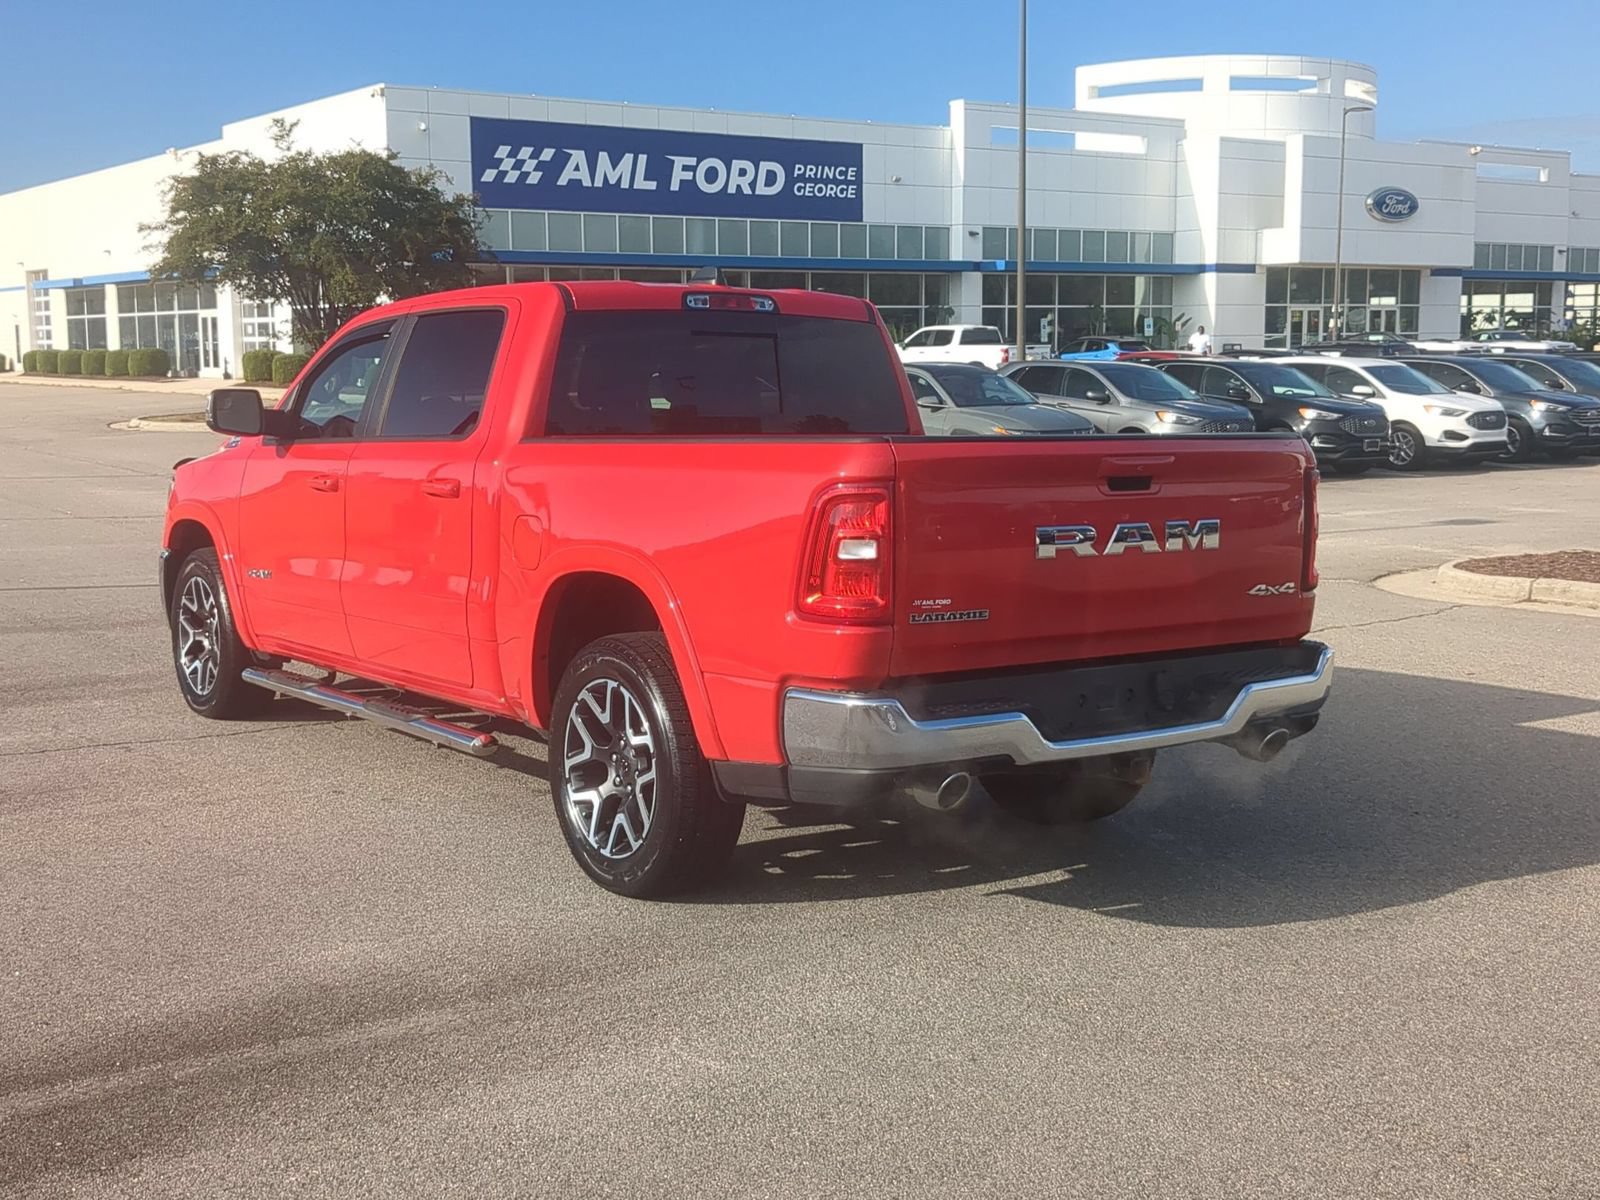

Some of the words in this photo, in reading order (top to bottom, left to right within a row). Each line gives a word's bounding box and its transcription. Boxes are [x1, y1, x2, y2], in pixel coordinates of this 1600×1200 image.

[556, 148, 657, 190] AML
[665, 155, 786, 196] FORD
[793, 164, 857, 181] PRINCE
[793, 182, 857, 199] GEORGE
[1382, 194, 1411, 214] Ford
[1035, 518, 1221, 560] RAM
[909, 609, 989, 624] LARAMIE
